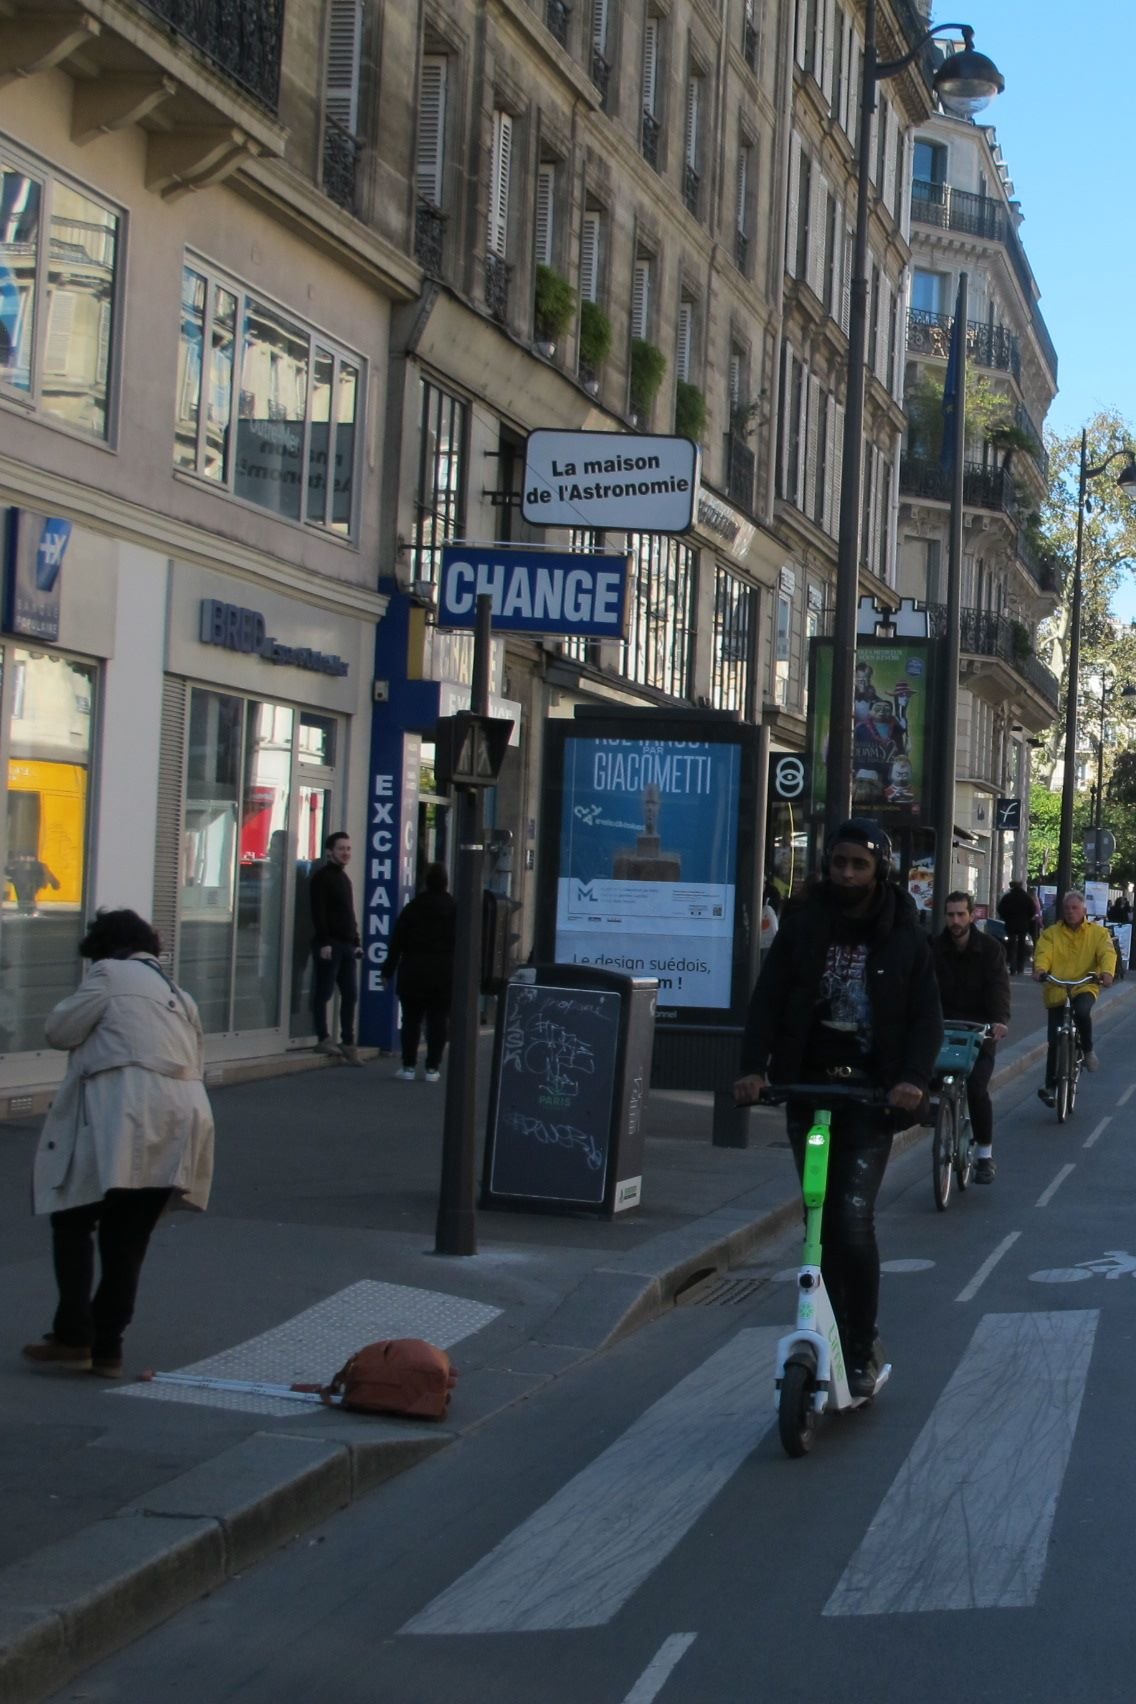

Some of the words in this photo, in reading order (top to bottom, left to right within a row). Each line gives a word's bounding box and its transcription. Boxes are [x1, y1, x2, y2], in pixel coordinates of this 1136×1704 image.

[551, 460, 577, 477] La
[583, 454, 661, 475] maison
[526, 486, 552, 504] de
[558, 475, 690, 502] l'Astronomie
[445, 561, 621, 624] CHANGE
[200, 598, 266, 654] BRED
[642, 747, 664, 755] PAR
[593, 752, 712, 795] GIACOMETTI
[368, 774, 394, 991] EXCHANGE
[650, 957, 711, 975] suédois,
